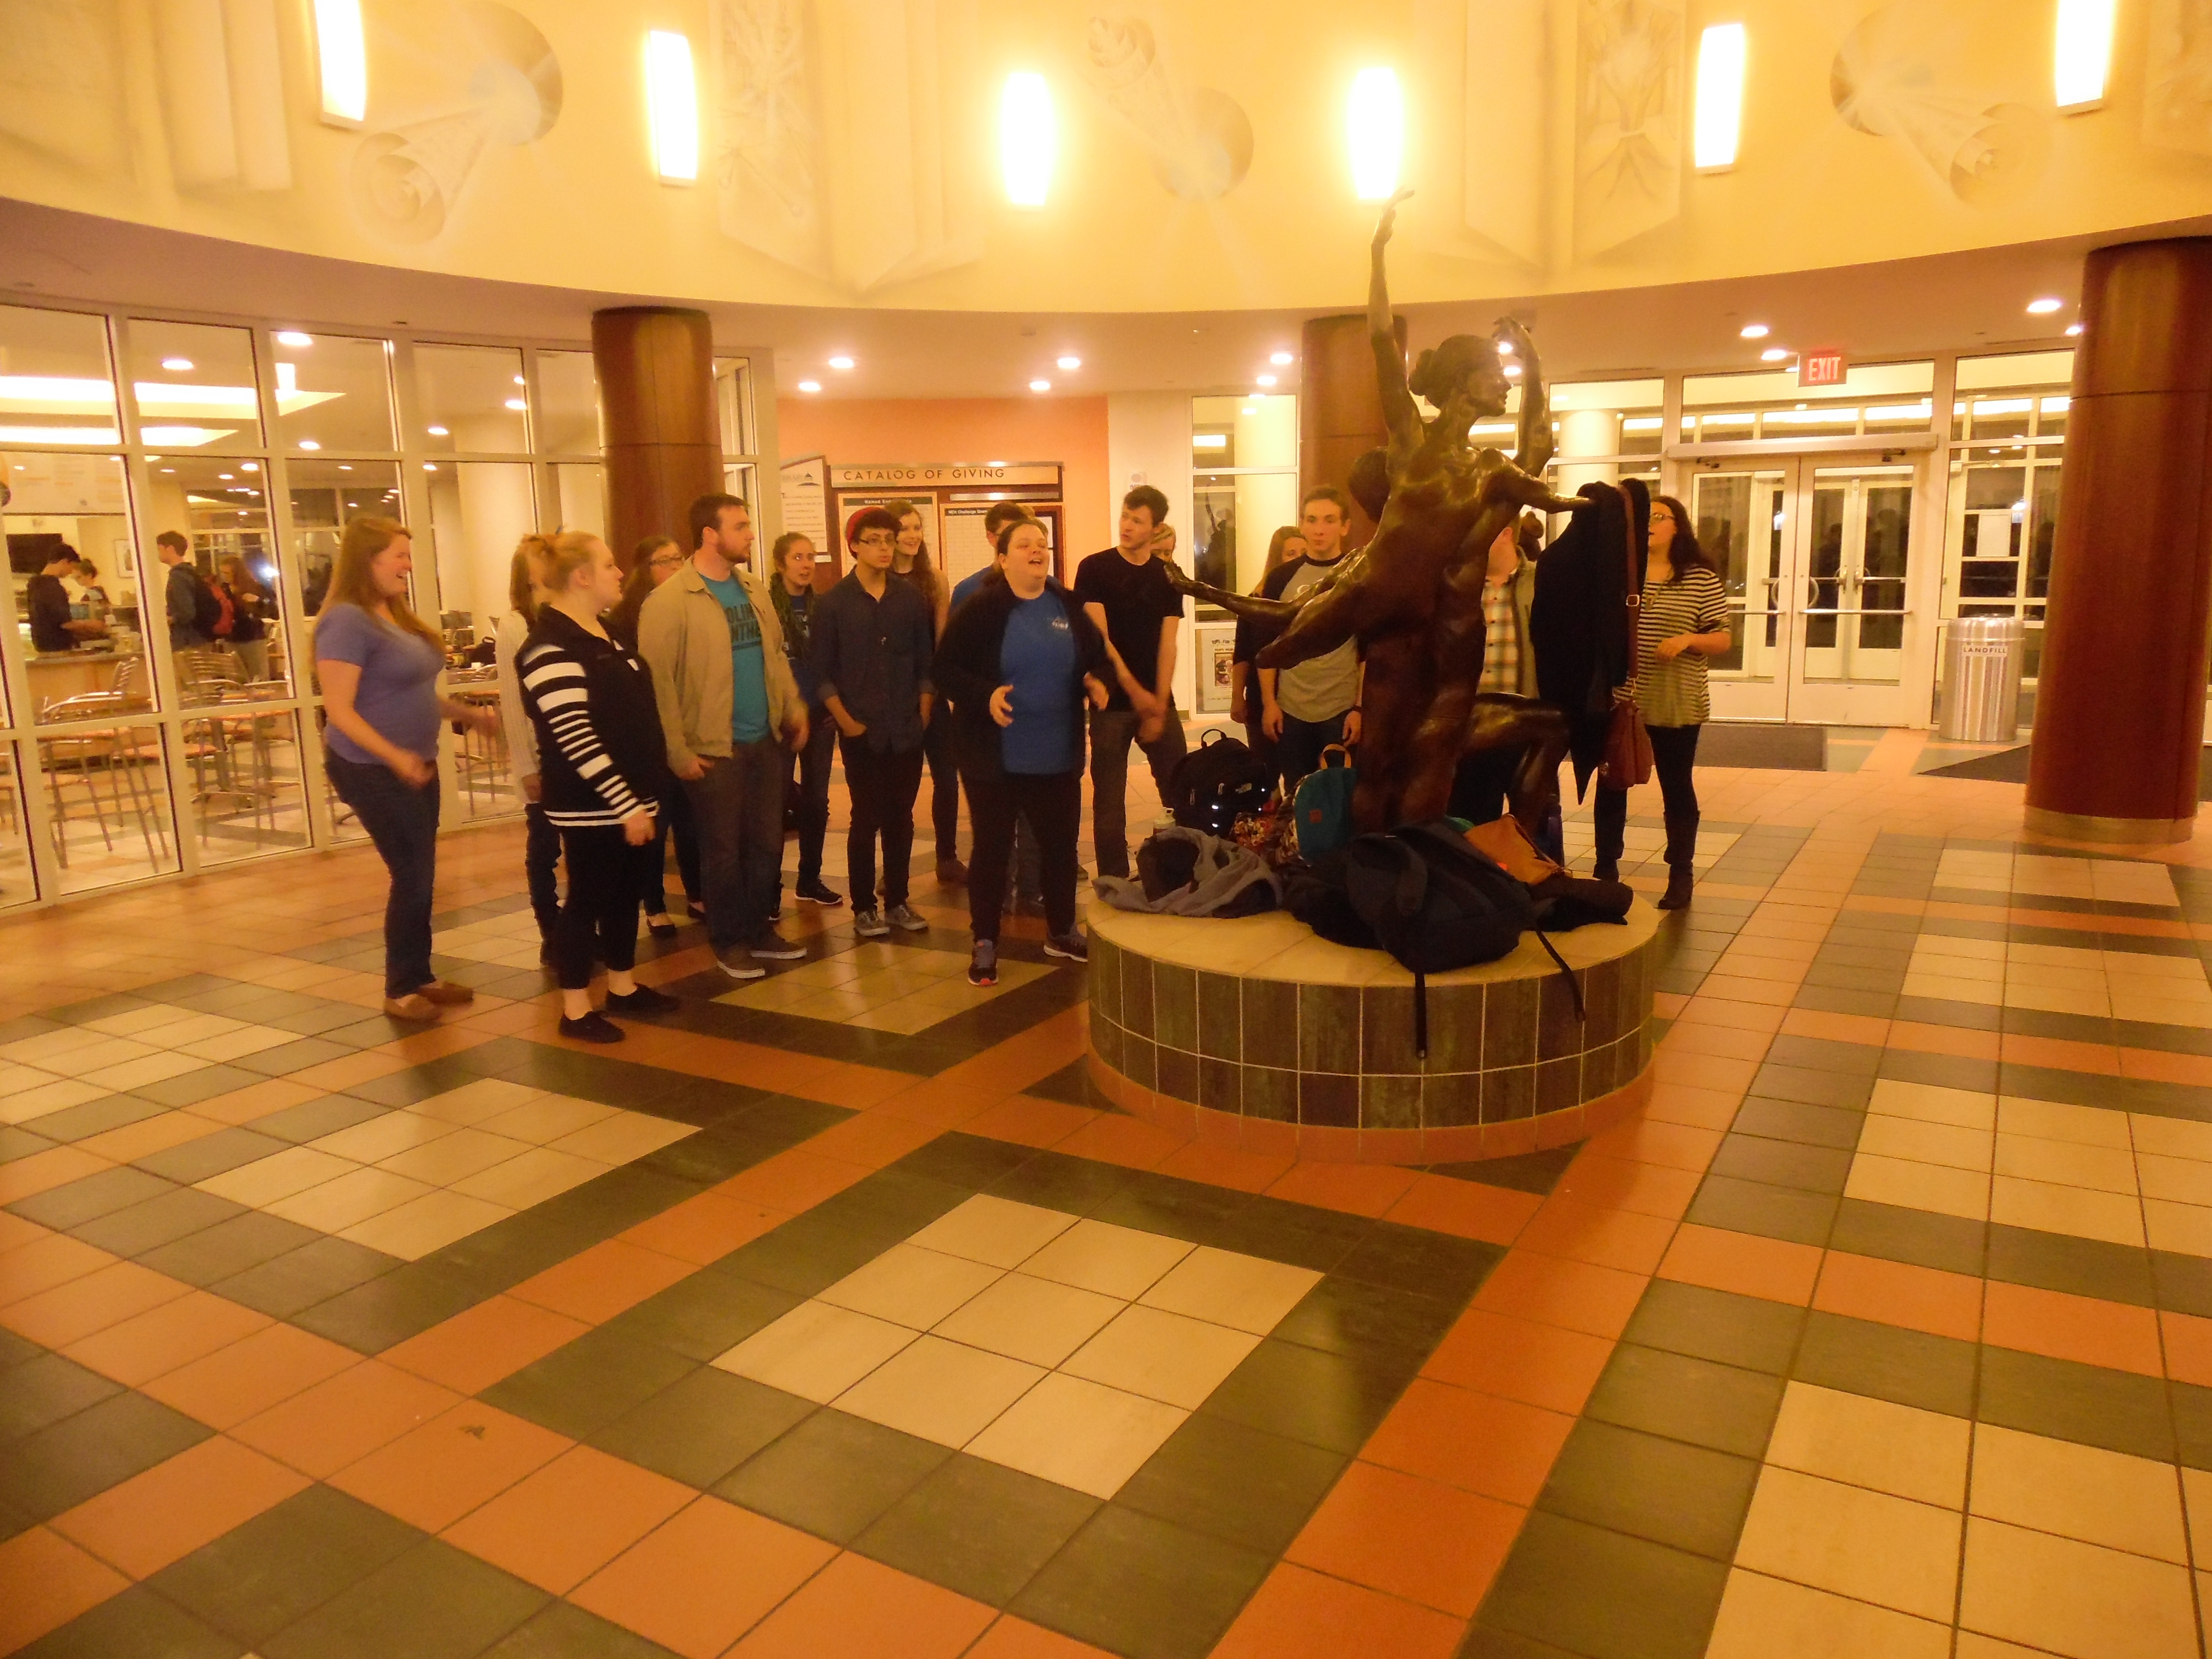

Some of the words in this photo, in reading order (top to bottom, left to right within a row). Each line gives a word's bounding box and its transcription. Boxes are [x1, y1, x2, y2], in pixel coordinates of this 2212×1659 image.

[1808, 356, 1841, 381] EXIT
[843, 469, 916, 481] CATALOG
[925, 469, 943, 479] OF
[952, 469, 1005, 478] GIVING
